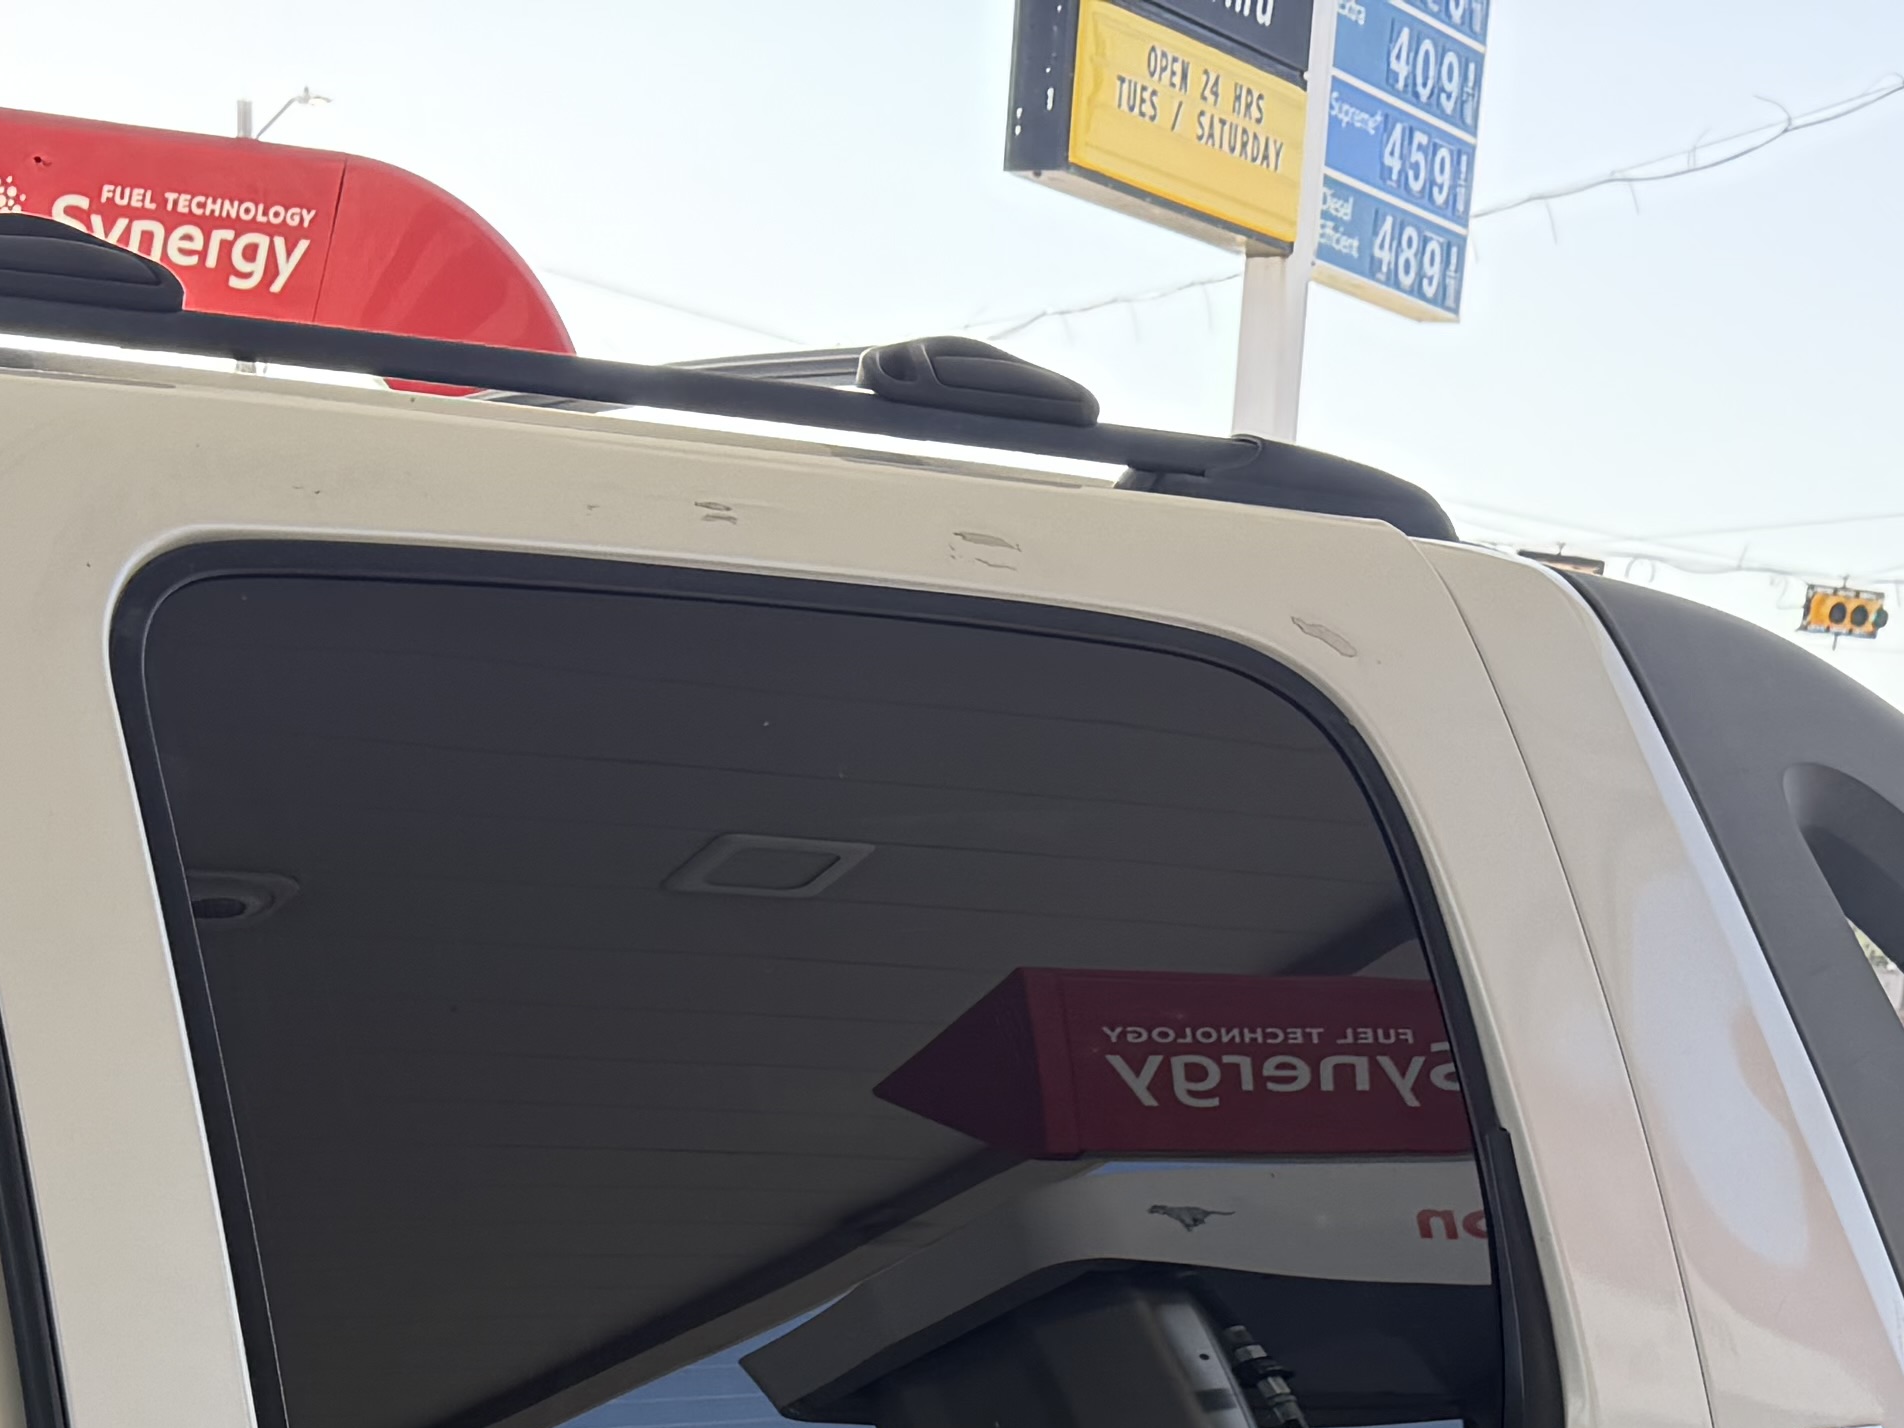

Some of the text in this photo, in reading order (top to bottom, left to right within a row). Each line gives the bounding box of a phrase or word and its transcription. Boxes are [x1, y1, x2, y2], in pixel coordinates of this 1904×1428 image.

[1147, 45, 1265, 125] OPEN 24 HRS
[1389, 26, 1460, 116] 409
[1117, 74, 1284, 172] TUES / SATURDAY
[1383, 122, 1452, 207] 459
[100, 184, 316, 228] FUEL TECHNOLOGY
[1372, 214, 1442, 298] 489
